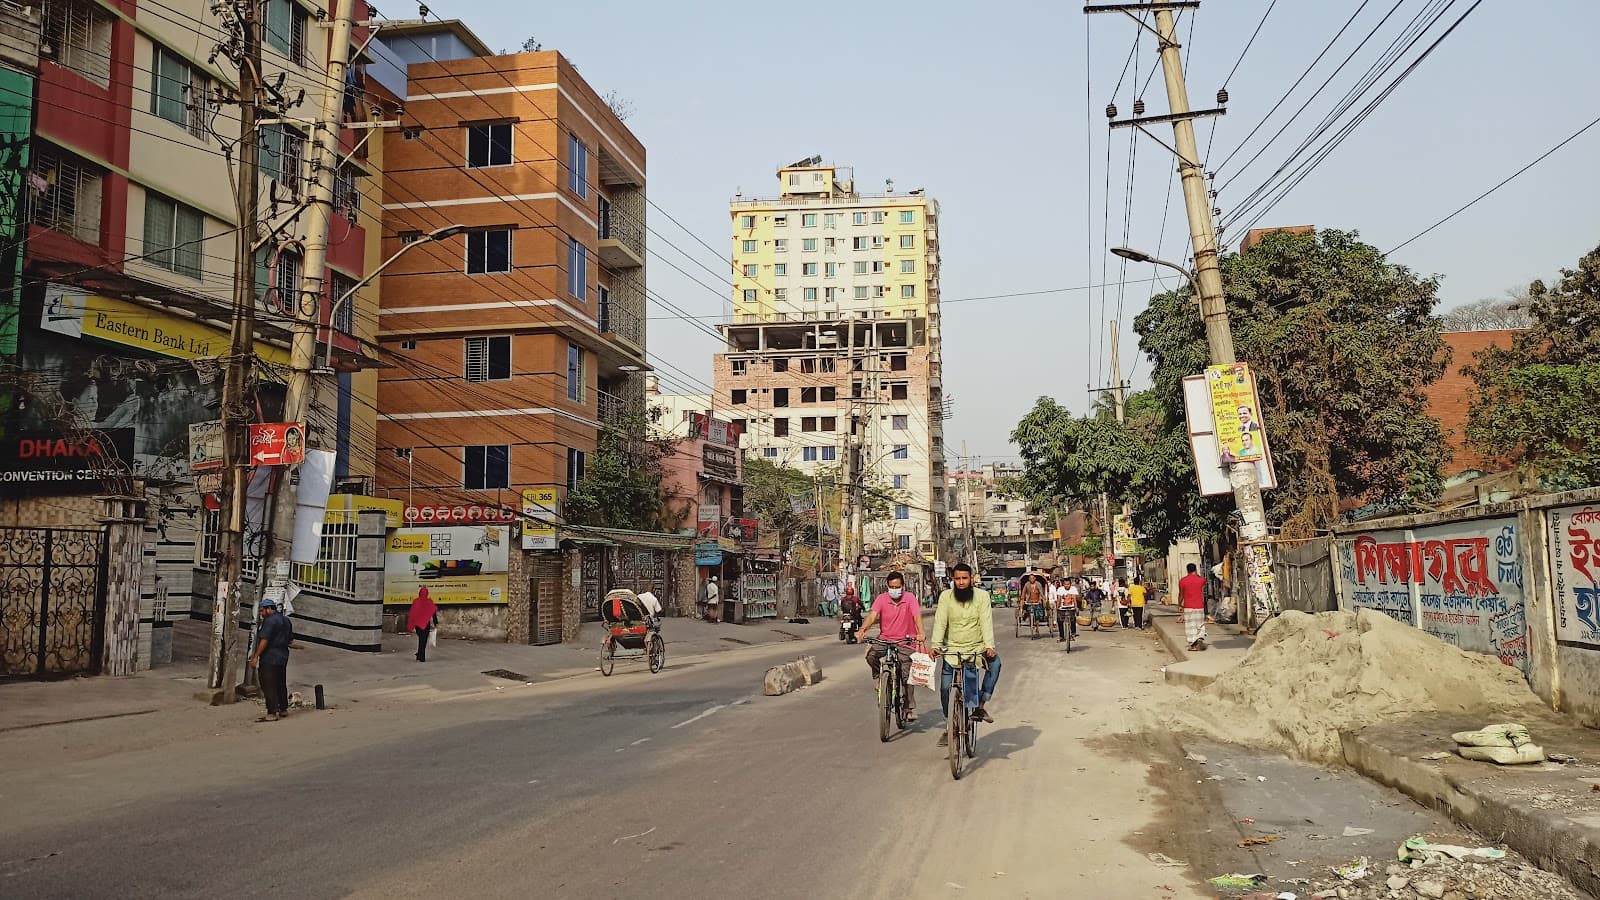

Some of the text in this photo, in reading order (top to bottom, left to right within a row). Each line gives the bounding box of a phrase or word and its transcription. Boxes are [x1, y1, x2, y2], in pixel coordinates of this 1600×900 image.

[95, 312, 210, 357] Eastern Bank Ltd
[19, 439, 102, 458] DHAKA
[0, 470, 73, 482] ONVENTION
[538, 493, 553, 501] 365
[1354, 535, 1499, 597] শিক্ষাগুরু
